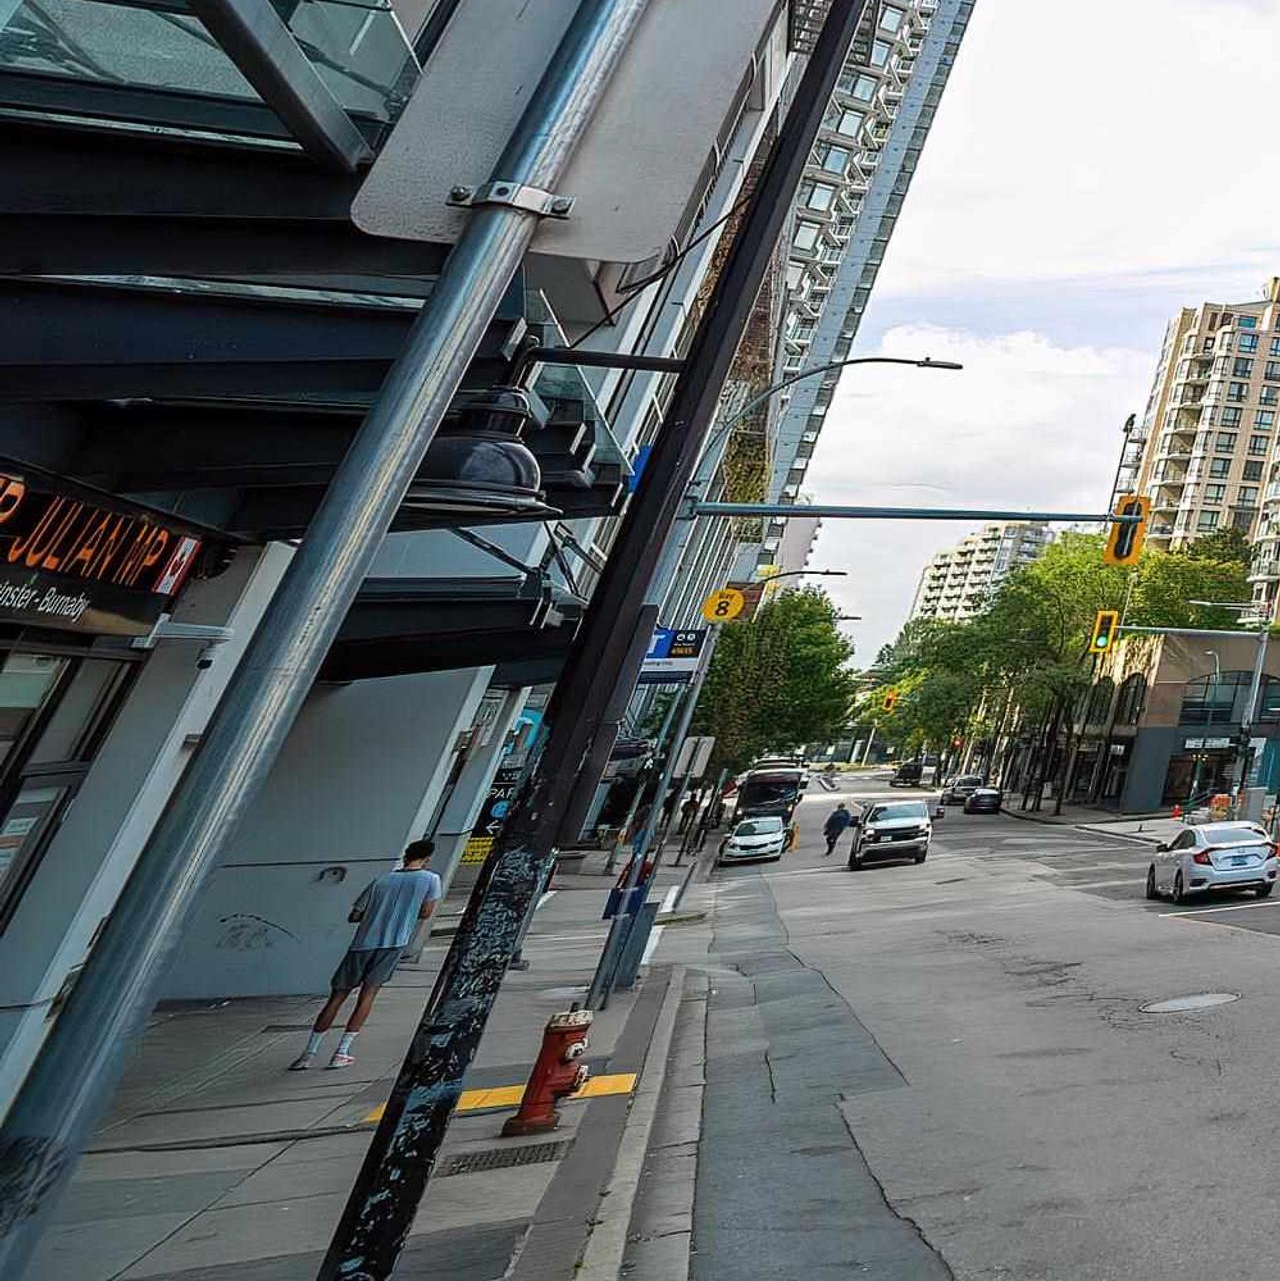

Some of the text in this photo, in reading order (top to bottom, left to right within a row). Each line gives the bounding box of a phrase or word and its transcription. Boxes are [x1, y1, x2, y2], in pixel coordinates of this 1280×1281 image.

[8, 494, 136, 580] JULIAN
[37, 586, 90, 623] Burnaby
[715, 600, 730, 616] 8
